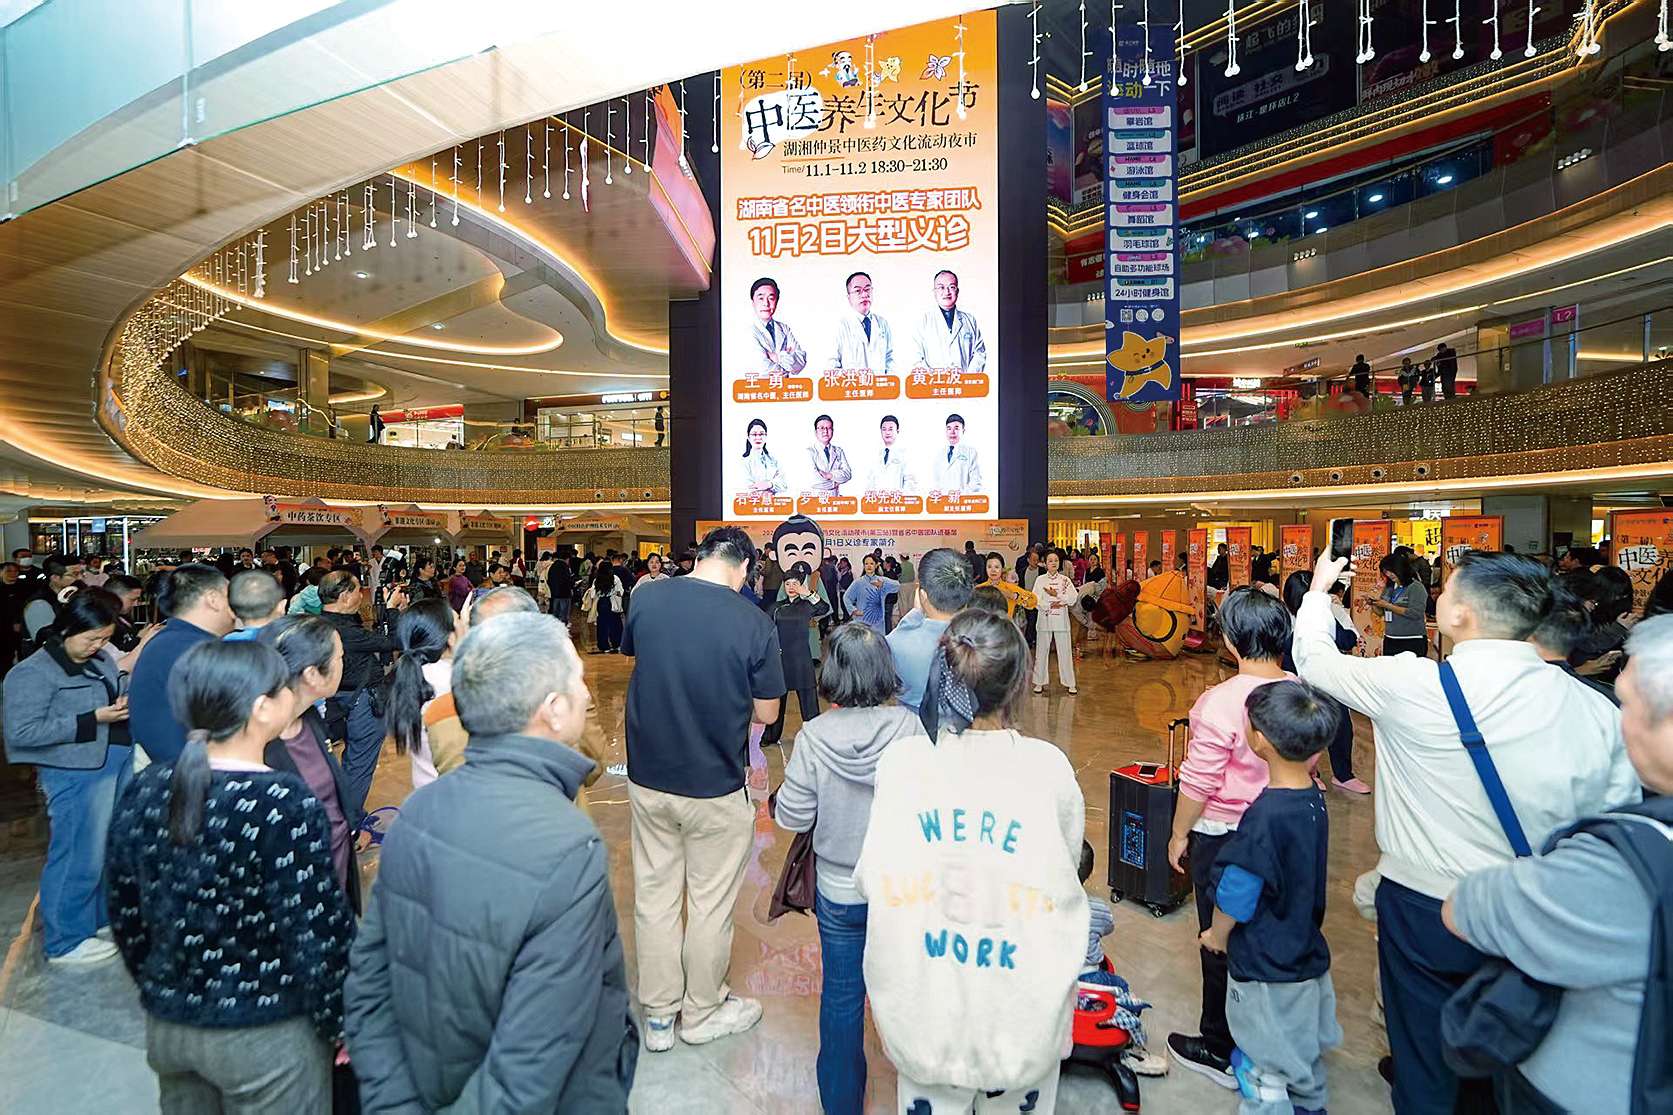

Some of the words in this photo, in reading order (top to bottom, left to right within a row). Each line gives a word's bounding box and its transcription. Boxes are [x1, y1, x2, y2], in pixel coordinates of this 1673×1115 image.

[745, 81, 979, 144] 中医养生文化节
[783, 132, 978, 157] 湖湘仲景中医药文化流动夜市
[871, 158, 948, 175] 18:30-21:30
[737, 187, 981, 220] 湖南省名中医领衔中医专家团队
[749, 215, 970, 257] 11月2日大型义诊
[1115, 287, 1170, 298] 24小时健身馆
[912, 367, 962, 385] 黄江波
[288, 511, 341, 523] 中药茶饮专区
[917, 809, 1022, 853] WERE
[925, 929, 1018, 970] WORK
